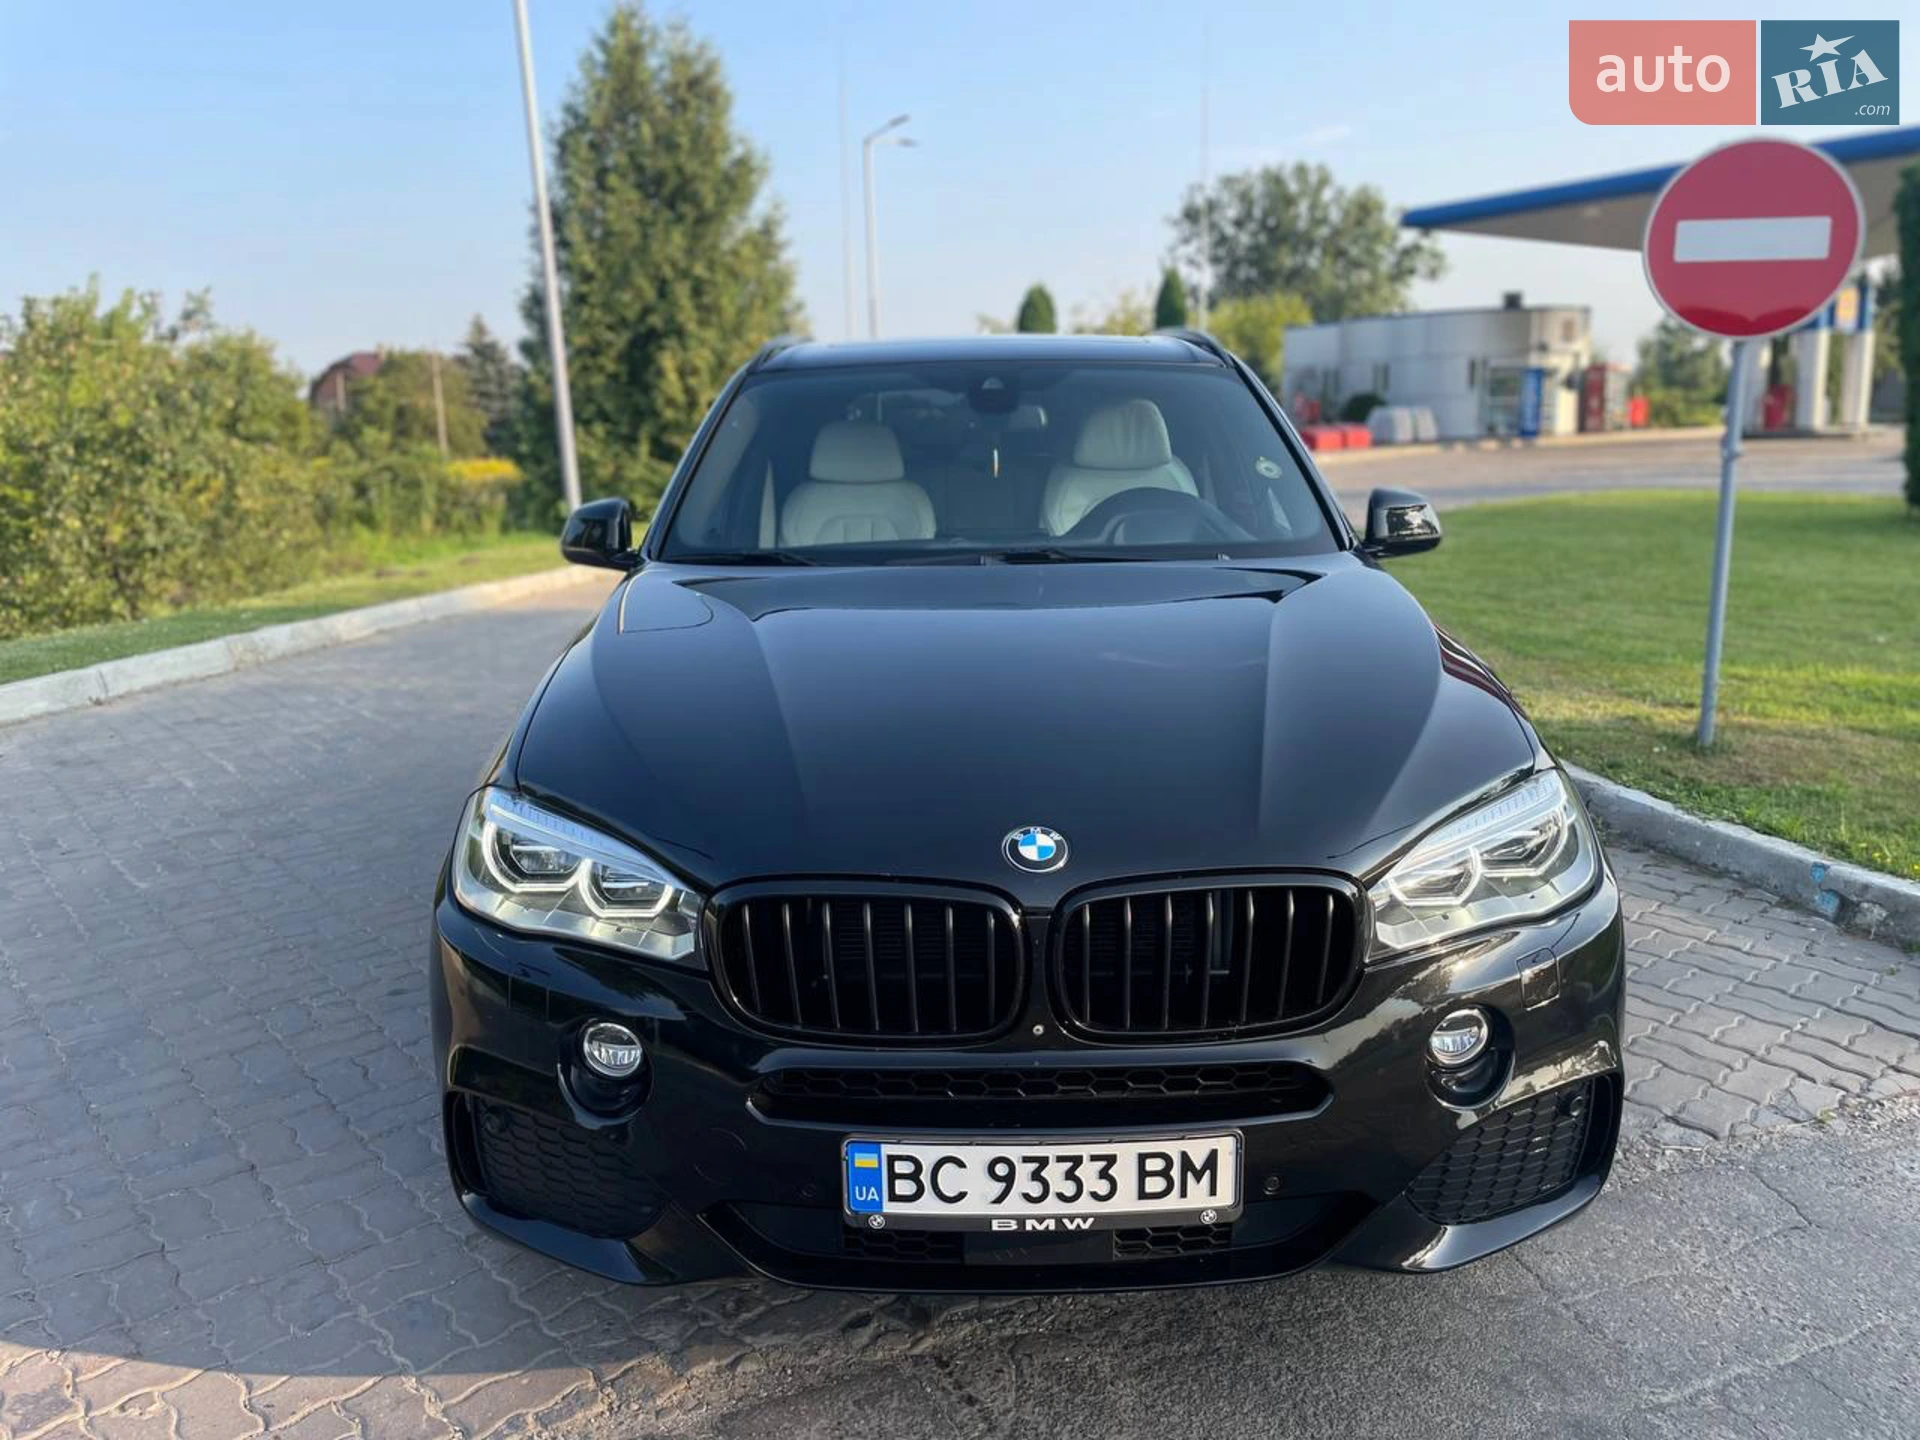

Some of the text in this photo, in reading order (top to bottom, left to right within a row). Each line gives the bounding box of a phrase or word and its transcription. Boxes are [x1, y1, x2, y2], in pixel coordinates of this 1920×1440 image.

[886, 1149, 1219, 1204] BC 9333 BM
[855, 1186, 880, 1201] UA
[991, 1217, 1095, 1231] BMW
